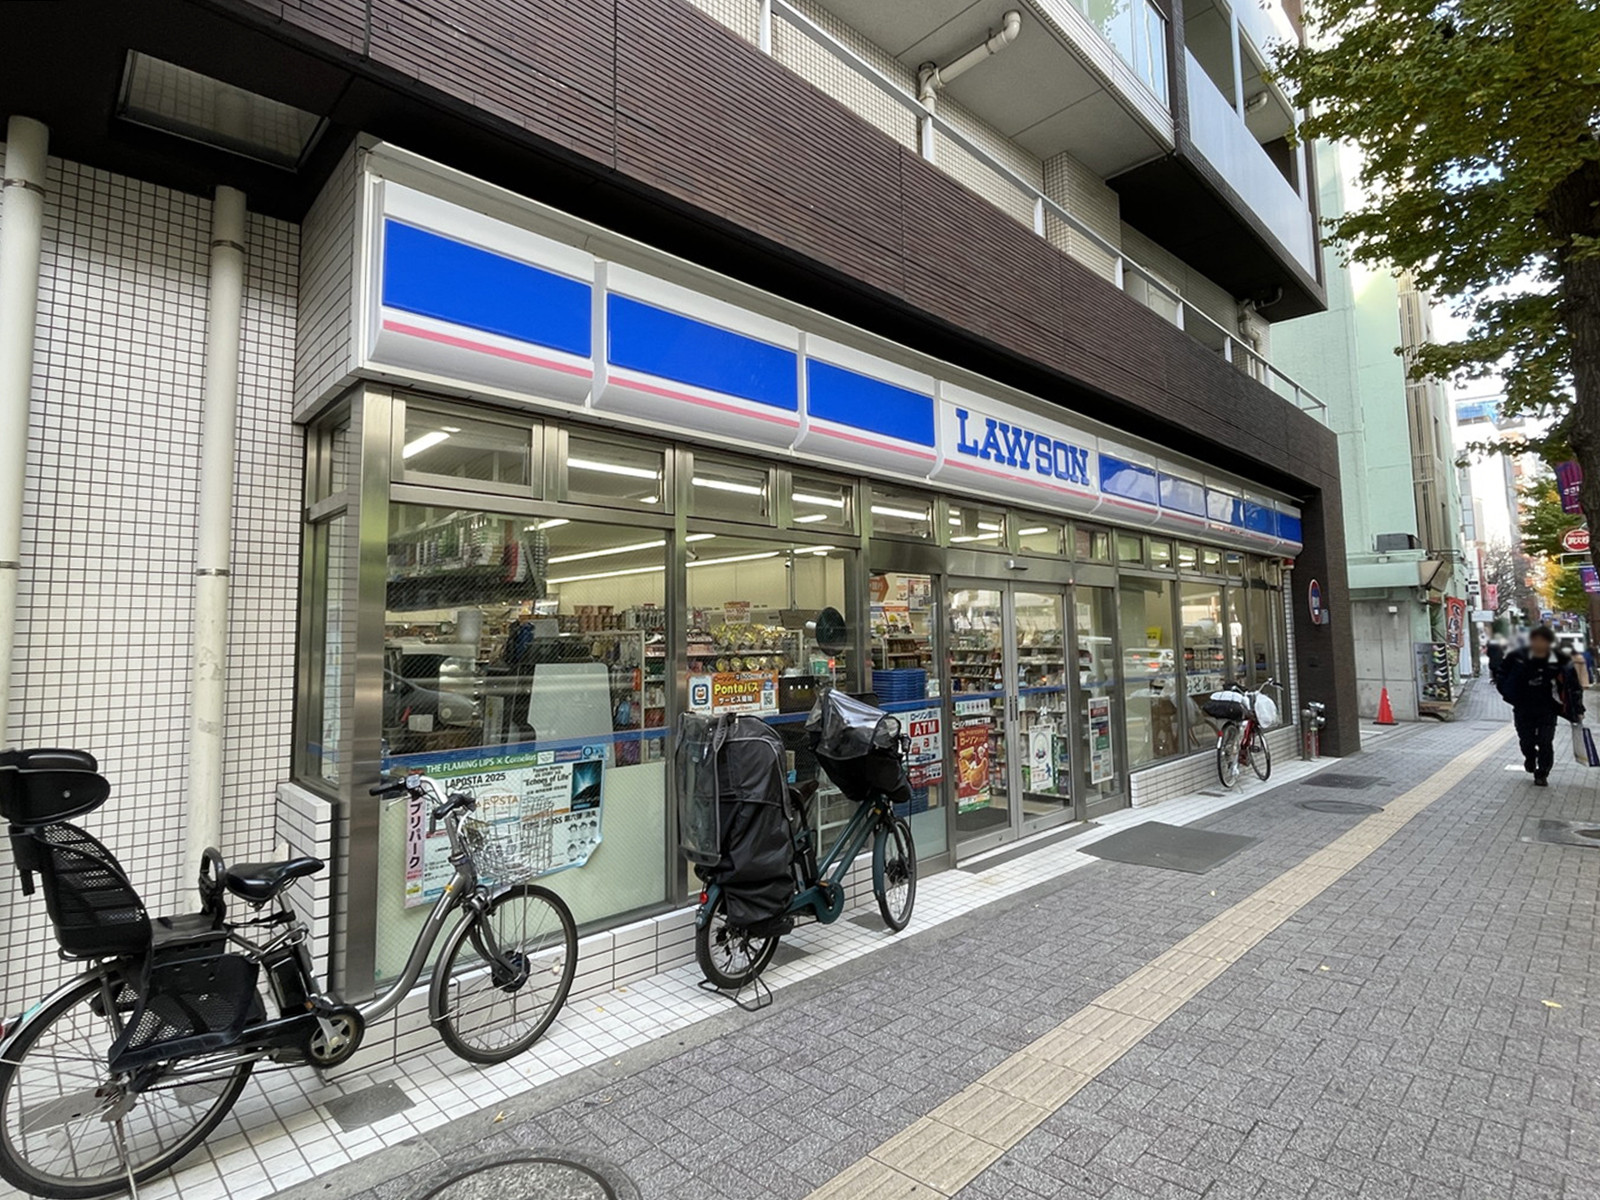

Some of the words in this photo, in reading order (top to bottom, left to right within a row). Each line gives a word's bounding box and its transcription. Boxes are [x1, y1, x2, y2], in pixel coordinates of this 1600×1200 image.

[956, 407, 1090, 487] LAWSON
[714, 681, 759, 695] Pontaパス
[914, 721, 936, 736] ATM
[426, 764, 442, 773] THE
[443, 759, 477, 771] FLAMING
[479, 757, 495, 768] LIPS
[445, 776, 483, 789] LAPOSTA
[485, 772, 506, 782] 2025
